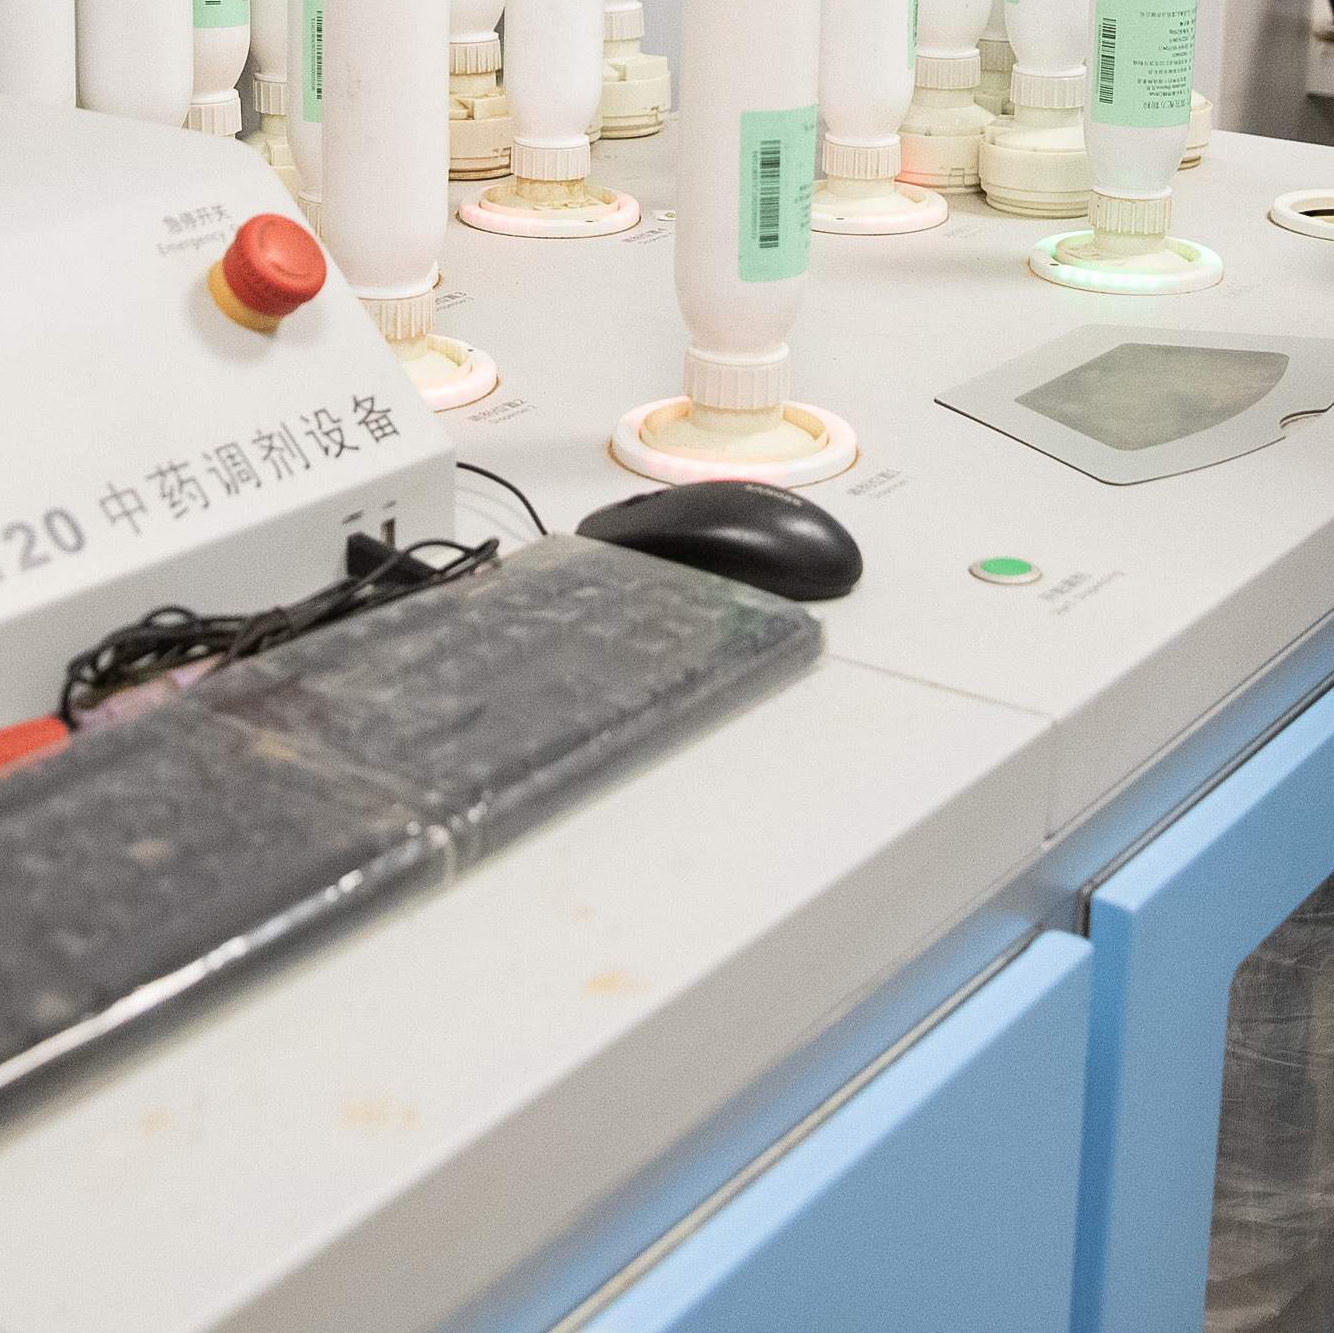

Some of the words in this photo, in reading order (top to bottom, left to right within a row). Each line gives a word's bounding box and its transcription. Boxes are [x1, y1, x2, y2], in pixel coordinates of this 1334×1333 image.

[97, 392, 400, 537] 中药调剂设备
